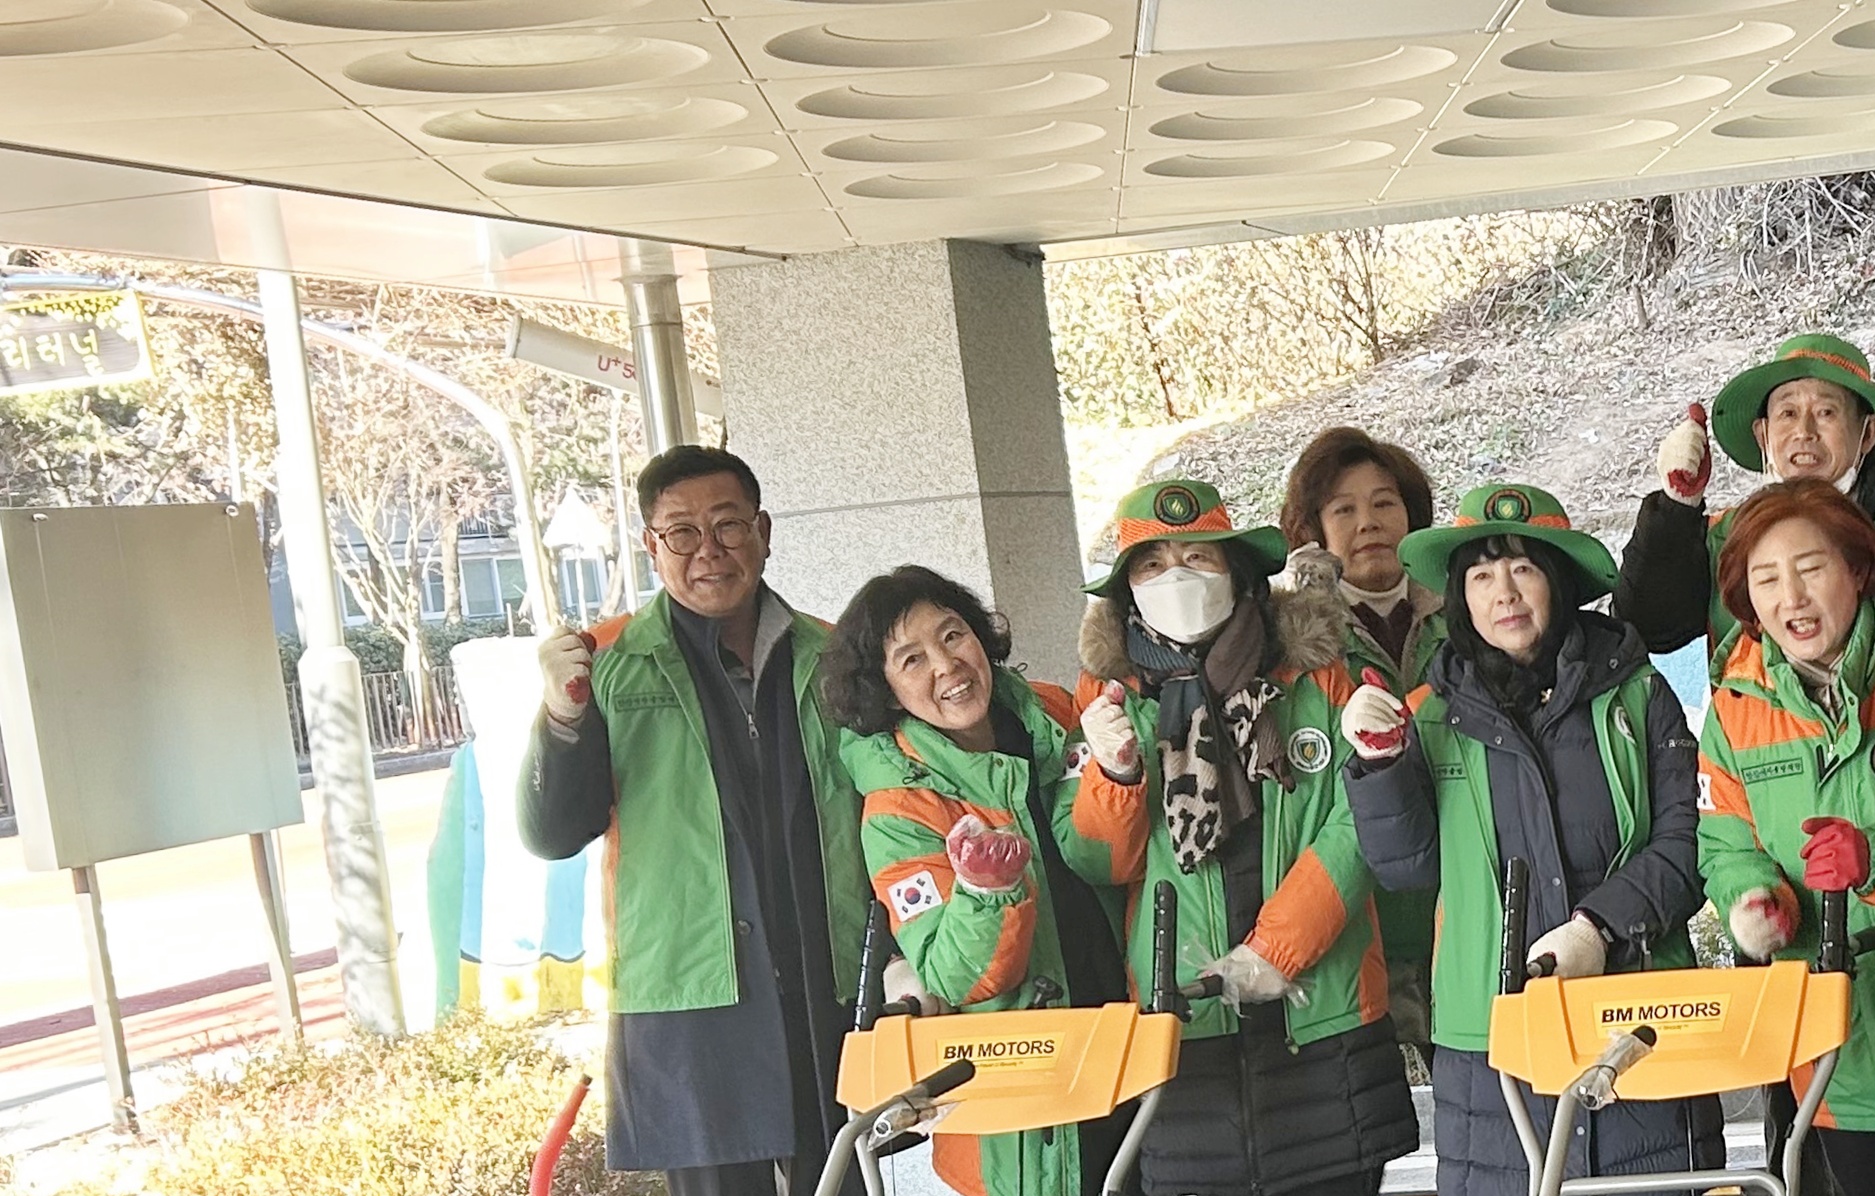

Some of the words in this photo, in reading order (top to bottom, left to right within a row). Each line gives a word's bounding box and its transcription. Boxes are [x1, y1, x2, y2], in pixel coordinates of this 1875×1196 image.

[622, 362, 637, 381] 5
[1601, 1007, 1633, 1023] BM
[1638, 1001, 1721, 1020] MOTORS
[943, 1044, 974, 1060] BM
[977, 1039, 1055, 1057] MOTORS
